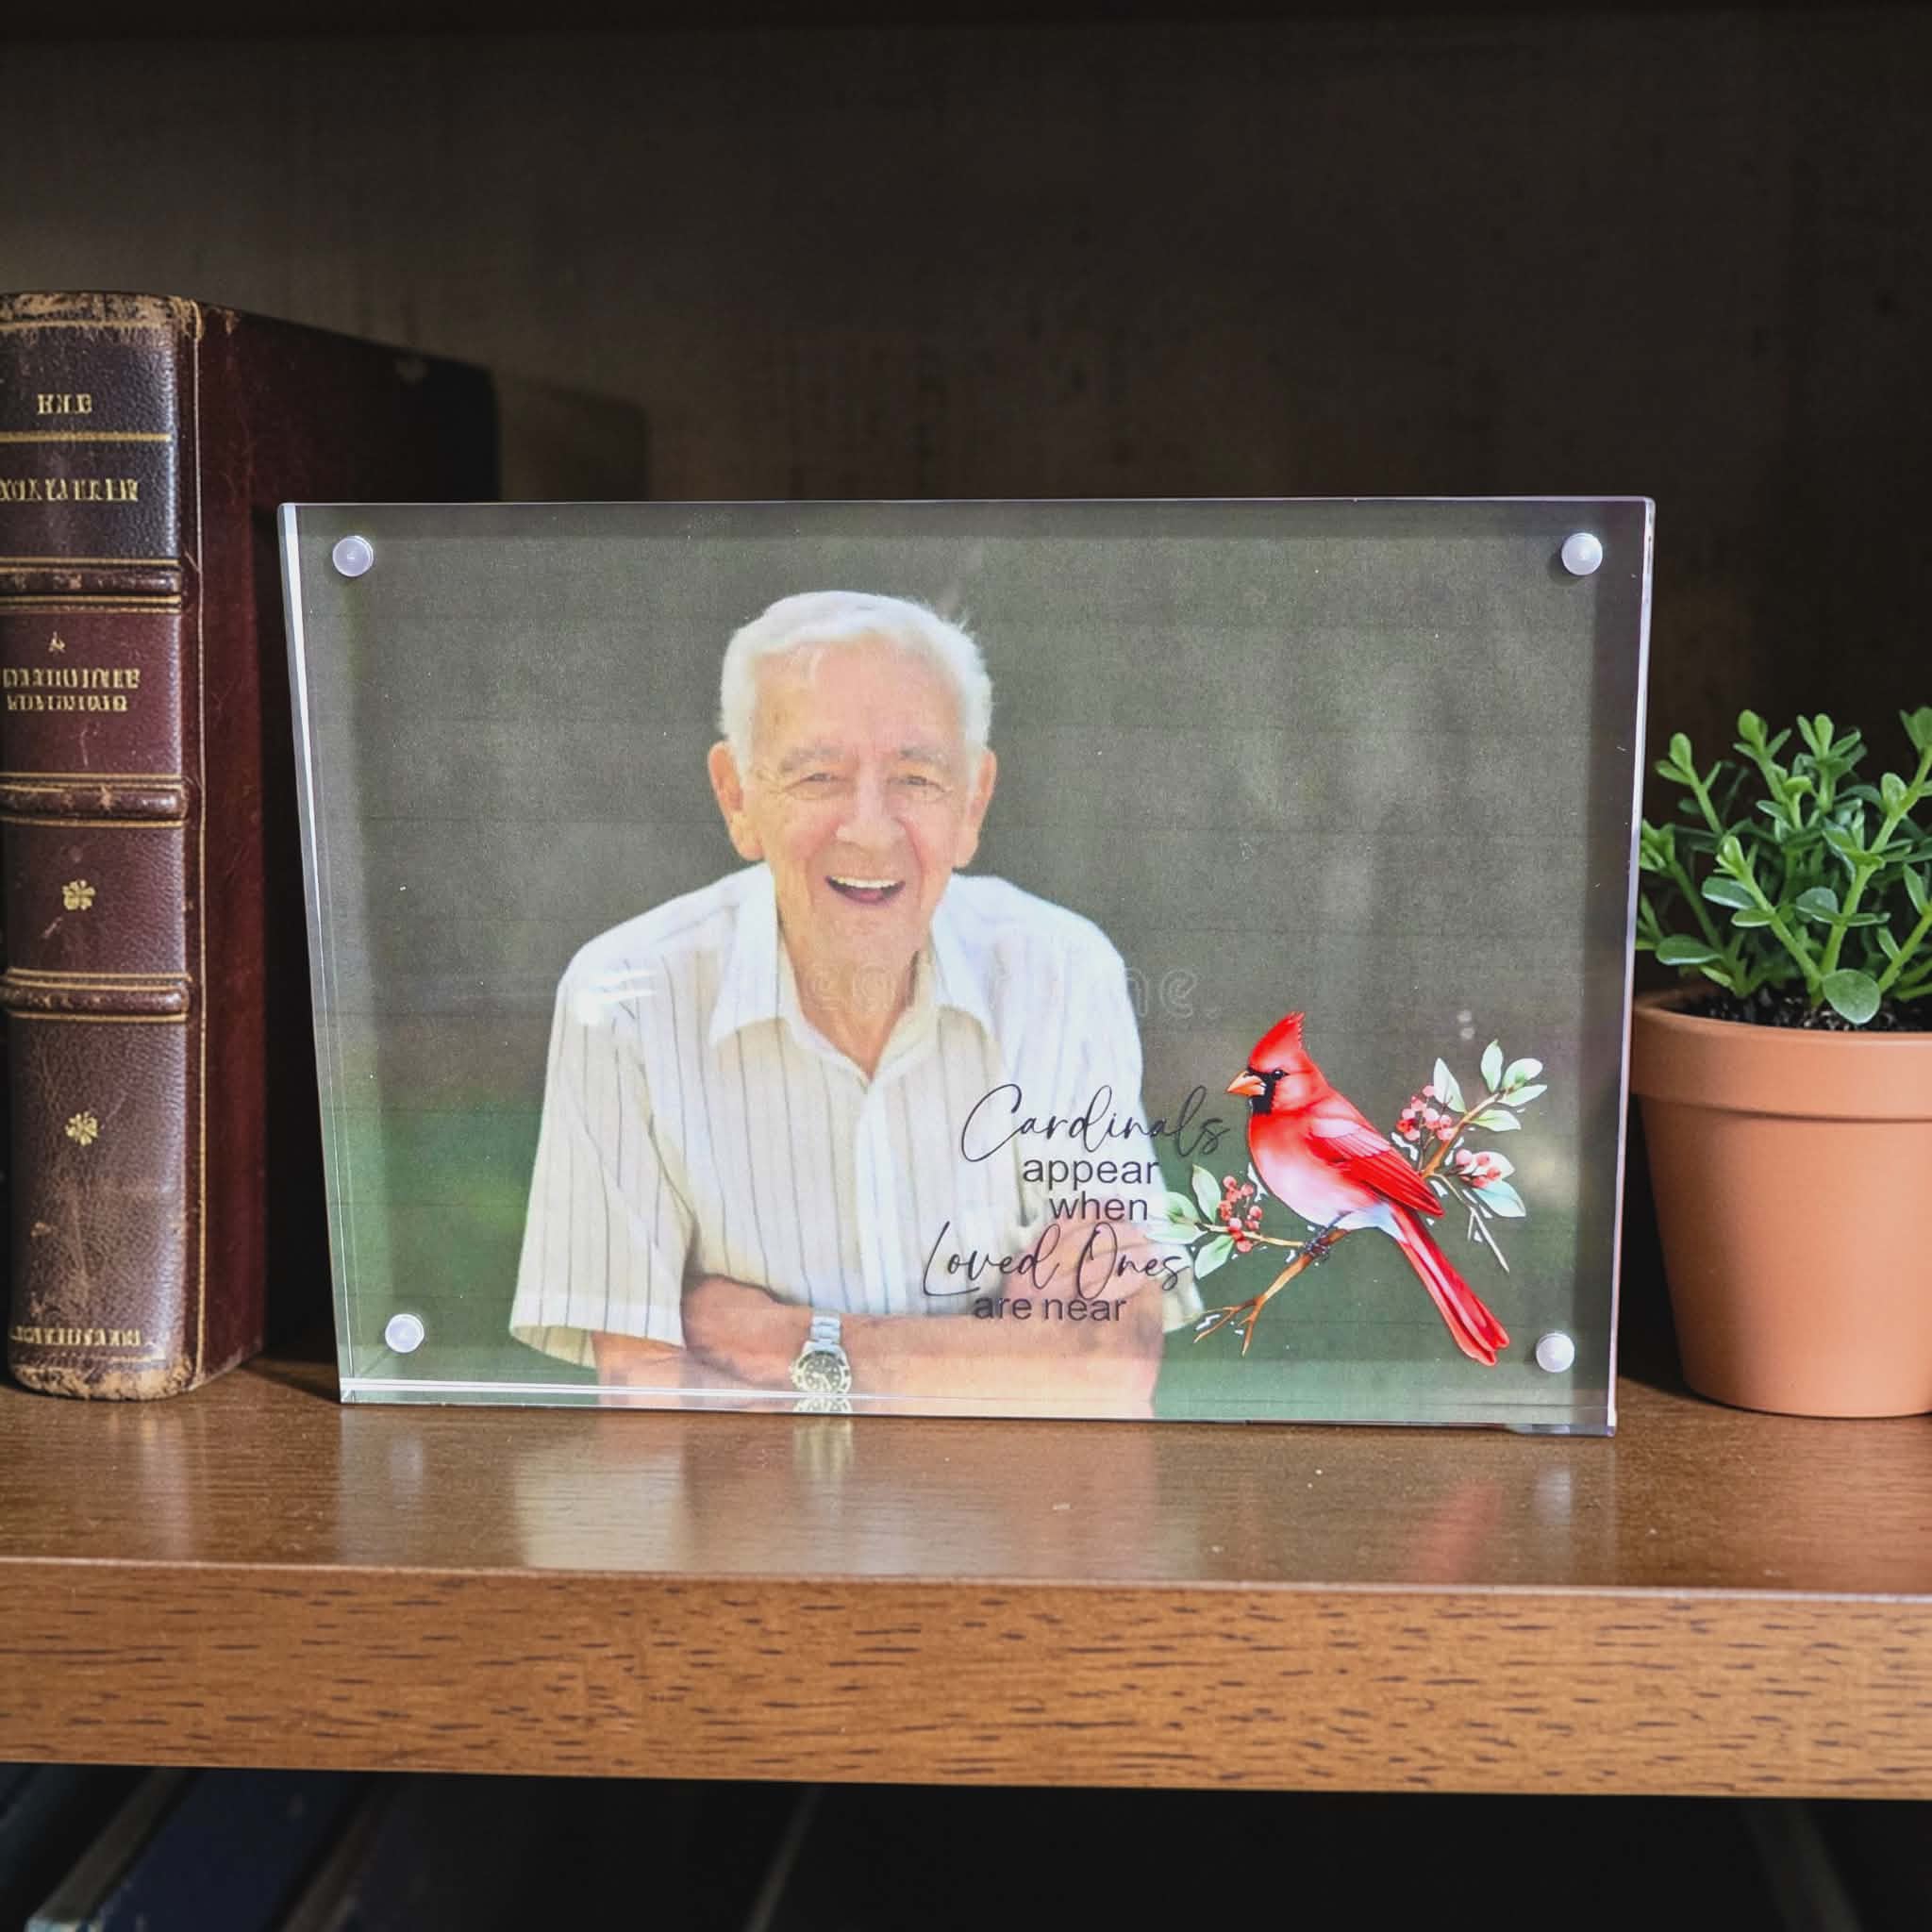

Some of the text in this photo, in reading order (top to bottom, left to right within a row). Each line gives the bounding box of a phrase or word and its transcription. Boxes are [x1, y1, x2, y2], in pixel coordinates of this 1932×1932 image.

[960, 1083, 1230, 1162] Cardinals
[1023, 1158, 1159, 1191] appear
[1048, 1191, 1148, 1222] when
[923, 1221, 1191, 1300] Loved Ones
[973, 1296, 1126, 1322] are near
